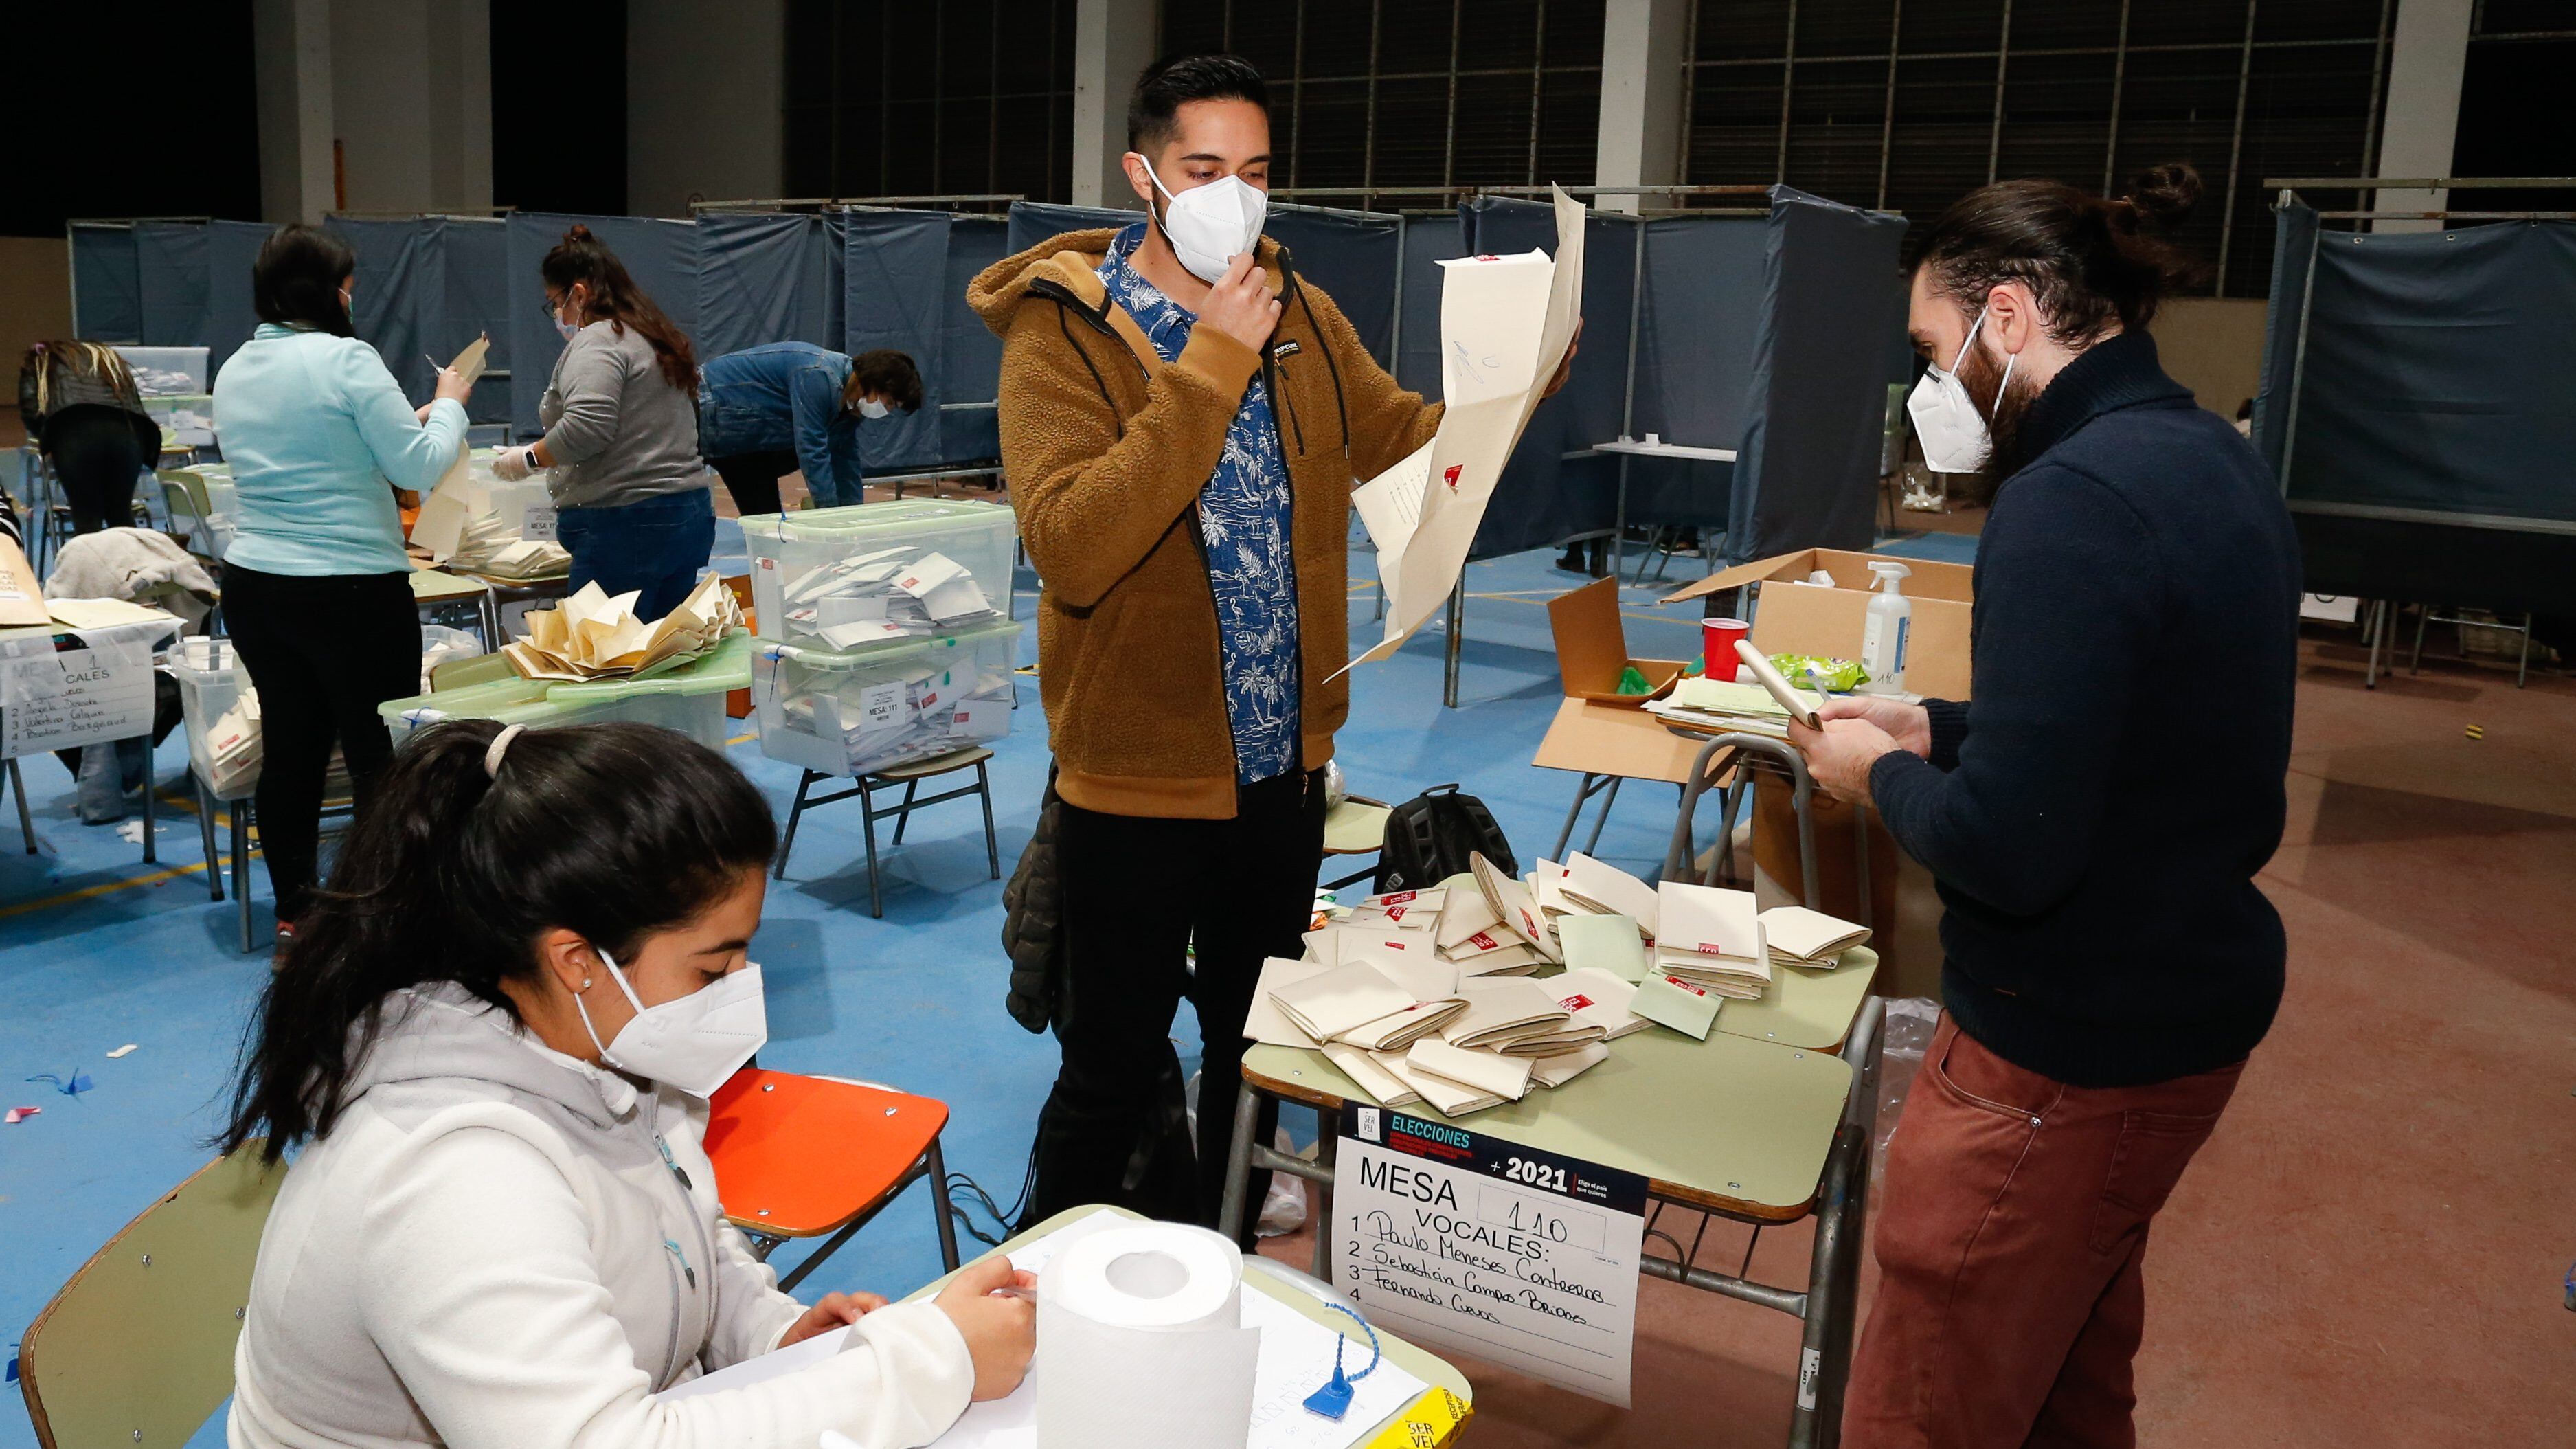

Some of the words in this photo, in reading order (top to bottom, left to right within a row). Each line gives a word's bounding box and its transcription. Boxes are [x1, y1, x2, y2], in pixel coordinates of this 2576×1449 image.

[65, 669, 111, 684] CALES
[1878, 673, 1895, 684] 110
[869, 706, 887, 715] MESA:
[888, 704, 897, 712] 111
[1364, 1115, 1375, 1125] SER
[1364, 1123, 1374, 1133] VEL
[1392, 1115, 1470, 1149] ELECCIONES
[1506, 1157, 1568, 1193] 2021
[1360, 1156, 1458, 1211] MESA
[1507, 1201, 1568, 1242] 110
[1415, 1209, 1549, 1263] VOCALES:
[1351, 1215, 1359, 1232] 1
[1367, 1210, 1429, 1251] Paulo
[1439, 1235, 1506, 1274] Meneses
[1515, 1257, 1604, 1303] Contreras
[1348, 1240, 1360, 1257] 2
[1464, 1271, 1515, 1303] Campos
[1349, 1264, 1360, 1280] 3
[1361, 1265, 1443, 1305] Fernando
[1451, 1294, 1500, 1325] Cuevas
[1349, 1288, 1361, 1302] 4
[1408, 1422, 1434, 1435] SER
